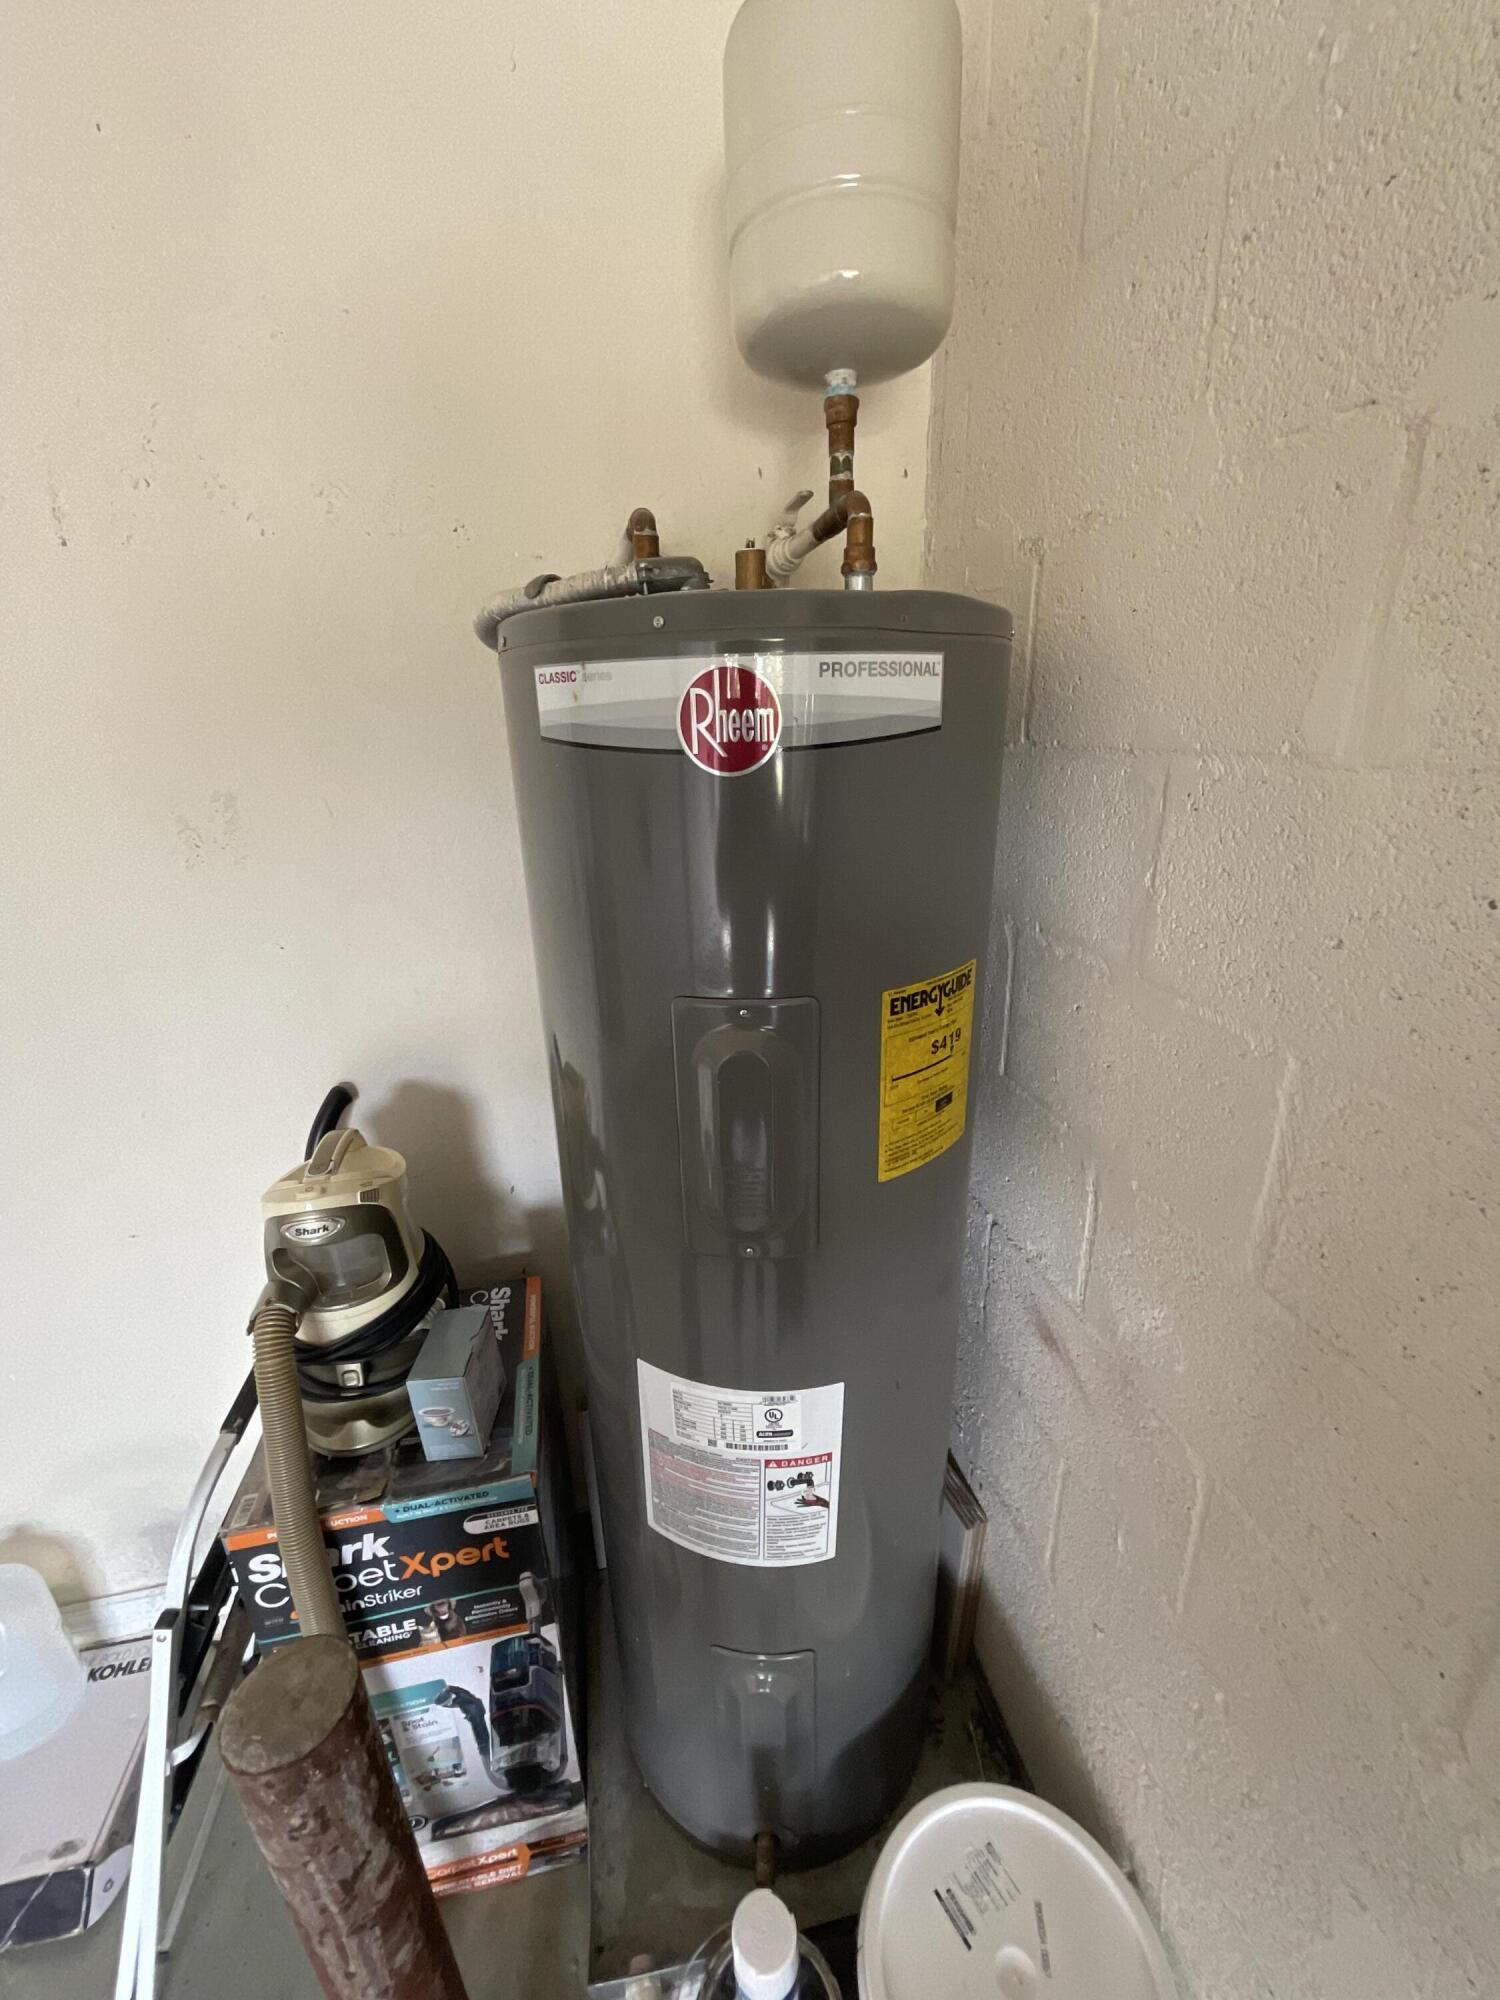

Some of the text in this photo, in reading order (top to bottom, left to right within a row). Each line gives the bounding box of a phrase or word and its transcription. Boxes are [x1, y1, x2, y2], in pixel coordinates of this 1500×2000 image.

[538, 668, 577, 685] CLASSIC
[818, 660, 940, 679] PROFESSIONAL
[688, 669, 776, 758] Rheem
[889, 967, 973, 1017] ENERGYGUIDE
[294, 1224, 330, 1237] Shark
[781, 1455, 828, 1467] DANGER
[403, 1491, 490, 1513] DUAL-ACTIVATED
[330, 1514, 368, 1527] UCTION
[248, 1532, 391, 1583] Srk
